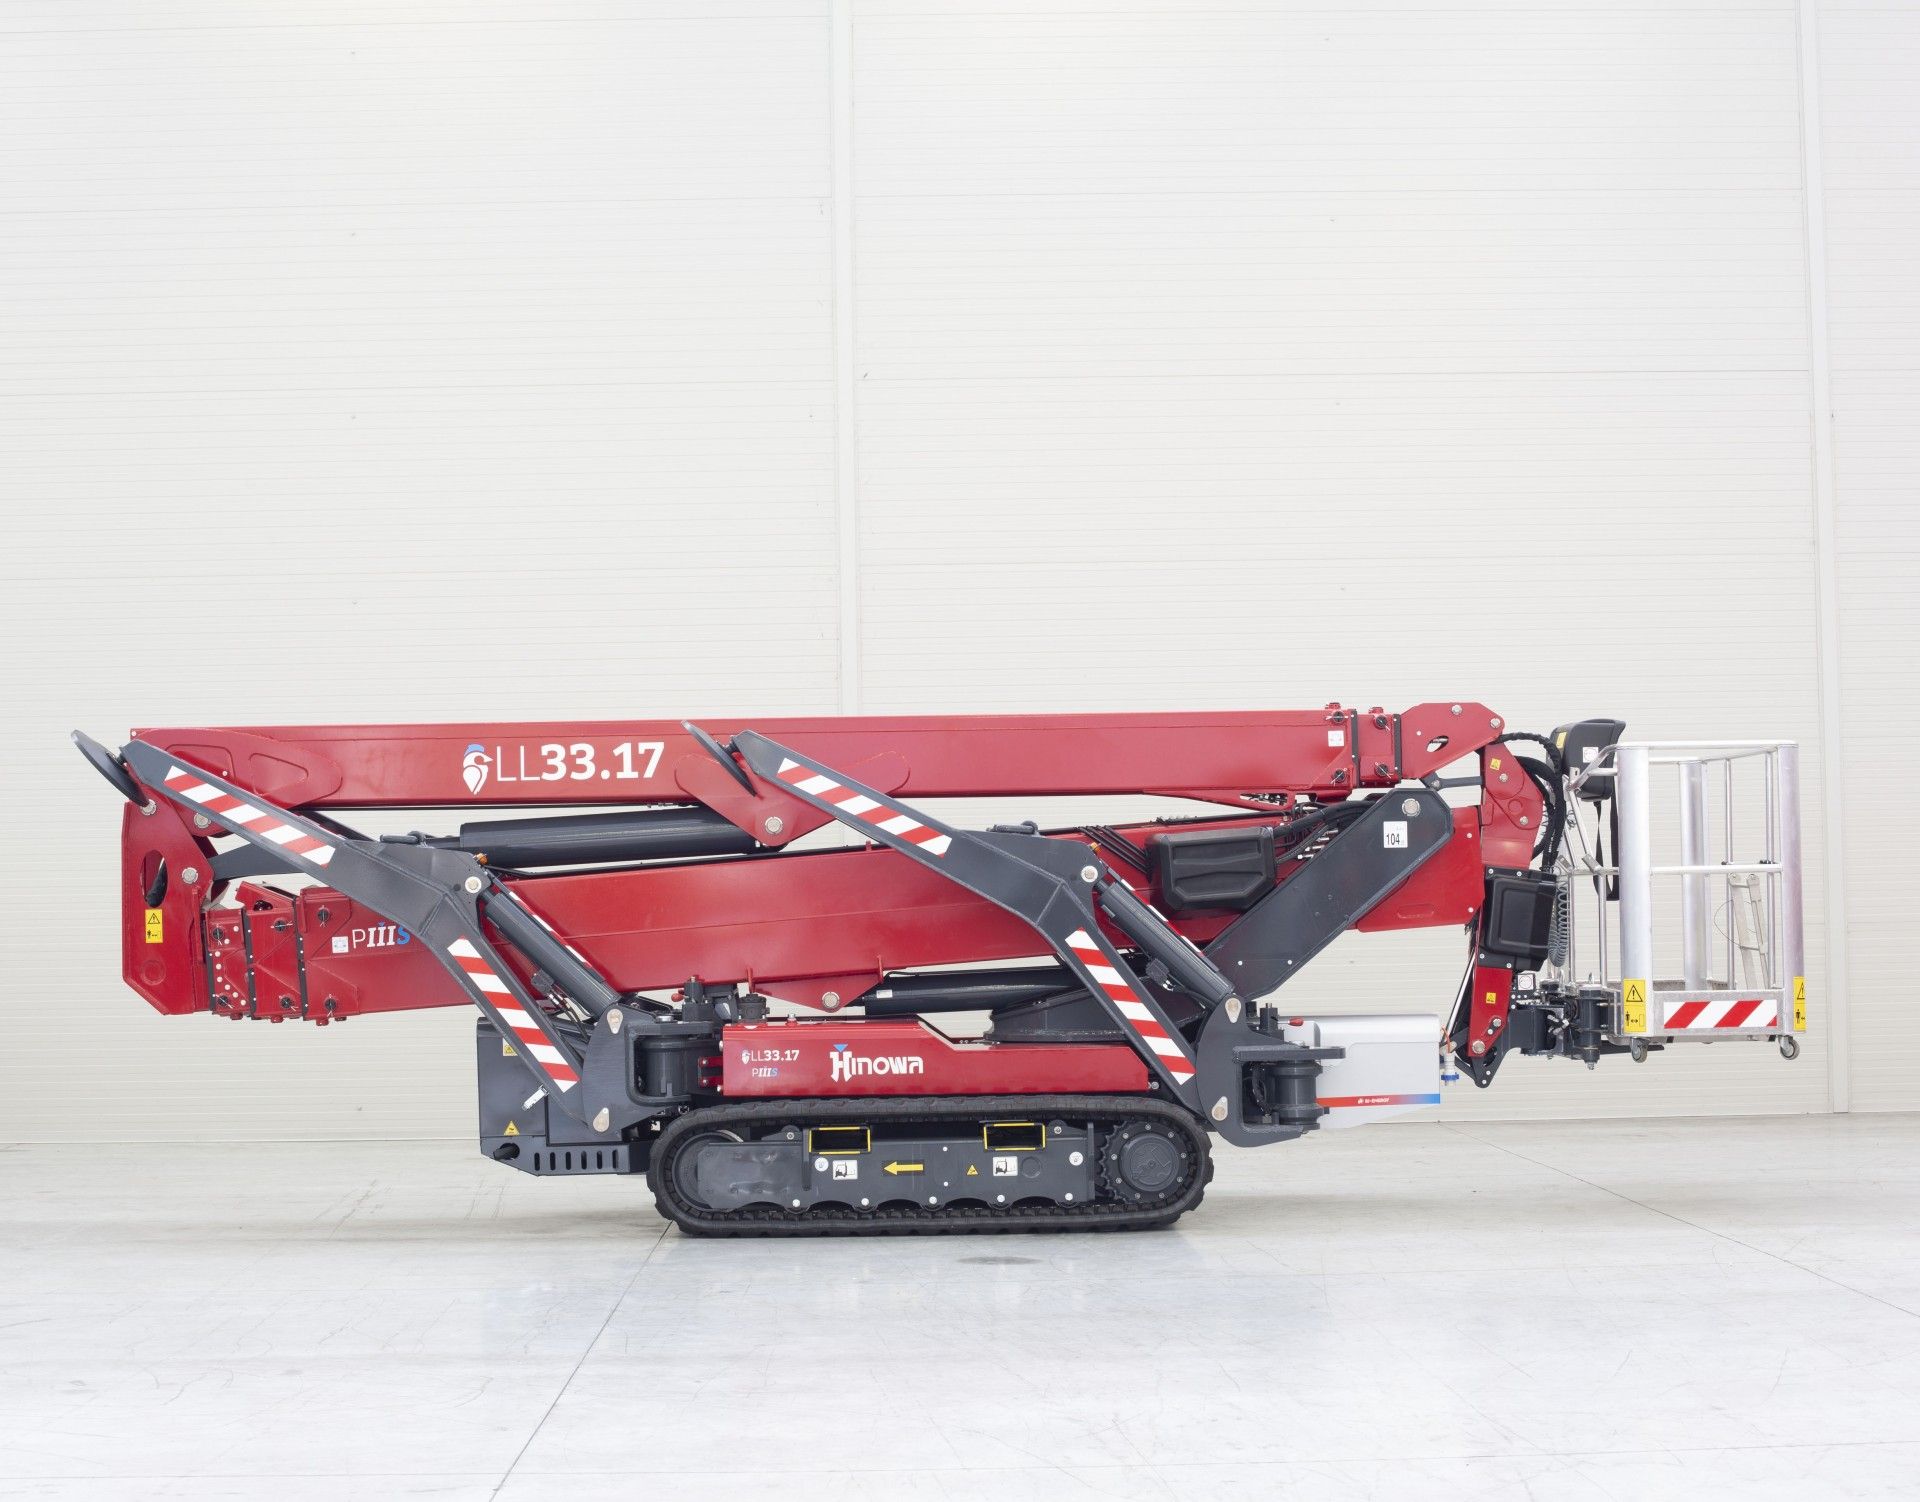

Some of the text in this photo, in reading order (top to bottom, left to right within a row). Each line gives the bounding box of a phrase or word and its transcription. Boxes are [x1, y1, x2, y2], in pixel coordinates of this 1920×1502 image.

[497, 742, 665, 782] LL33.17
[1386, 833, 1400, 846] 104
[751, 1049, 800, 1062] LL33.17
